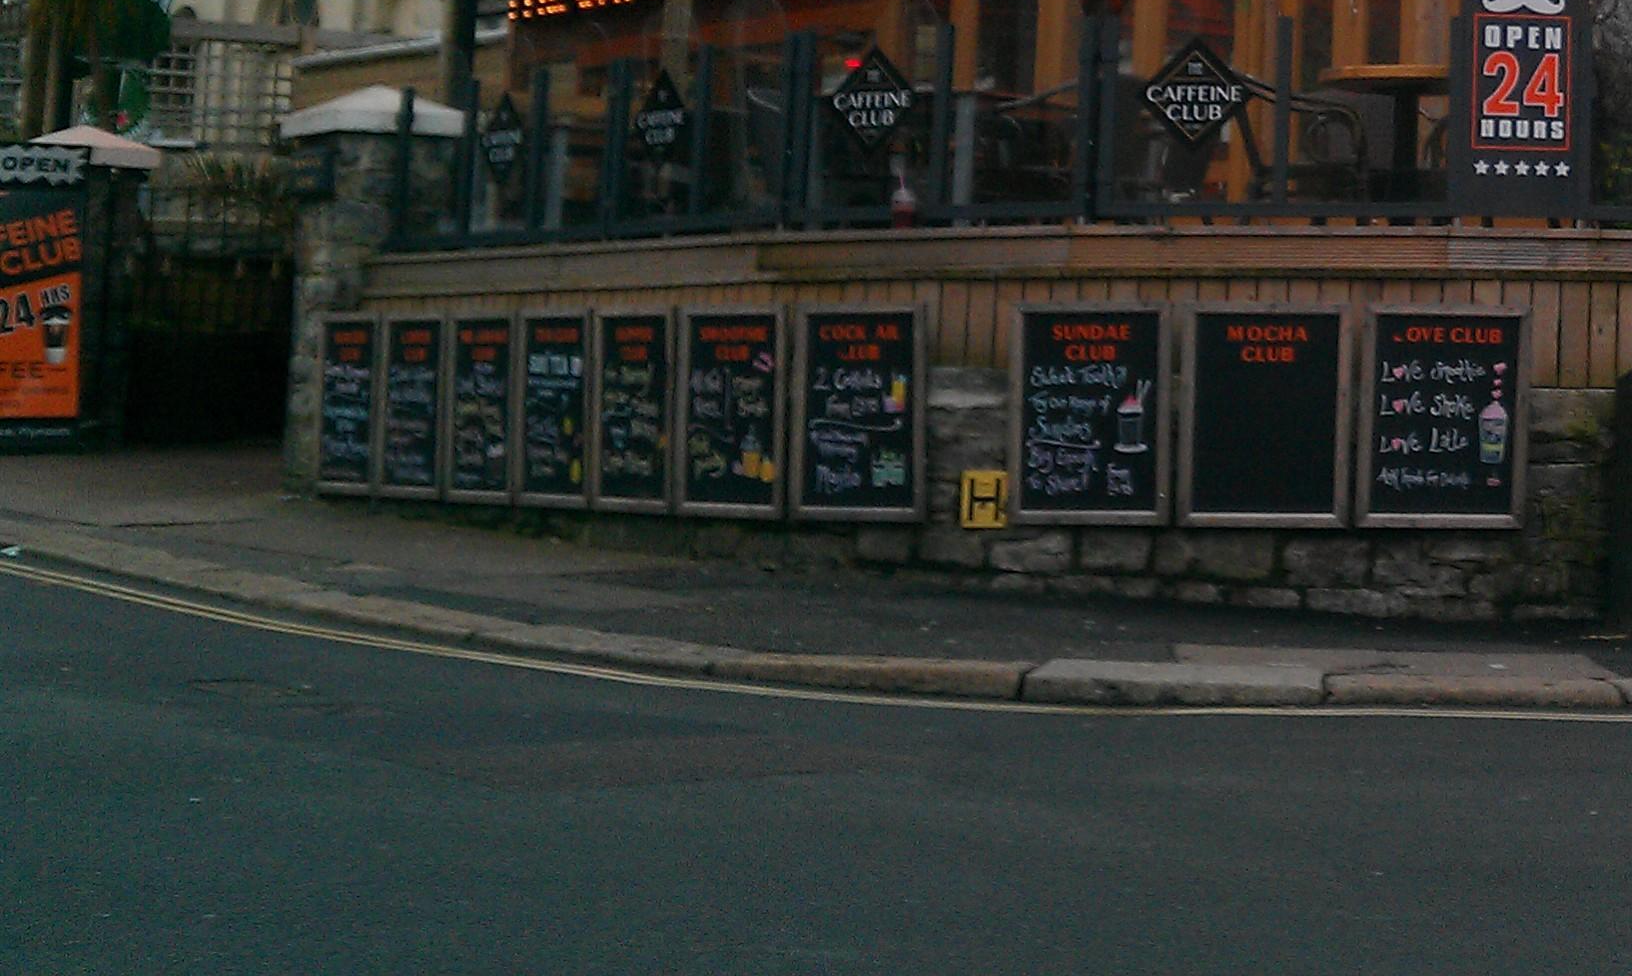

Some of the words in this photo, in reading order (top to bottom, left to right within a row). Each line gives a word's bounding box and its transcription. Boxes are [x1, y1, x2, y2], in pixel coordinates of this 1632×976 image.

[1484, 25, 1562, 49] OPEN
[1483, 51, 1564, 117] 24
[1146, 85, 1242, 103] CAFFEINE
[848, 109, 895, 127] CLUB
[1166, 104, 1222, 121] CLUB
[1480, 119, 1564, 140] HOURS
[3, 155, 71, 173] OPEN
[1, 236, 82, 276] CLUB
[1053, 324, 1131, 341] SUNDAE
[1227, 324, 1308, 342] MOCHA
[1393, 326, 1445, 344] OVE
[1450, 327, 1504, 344] CLUB
[1064, 344, 1118, 361] CLUB
[1241, 346, 1295, 363] CLUB
